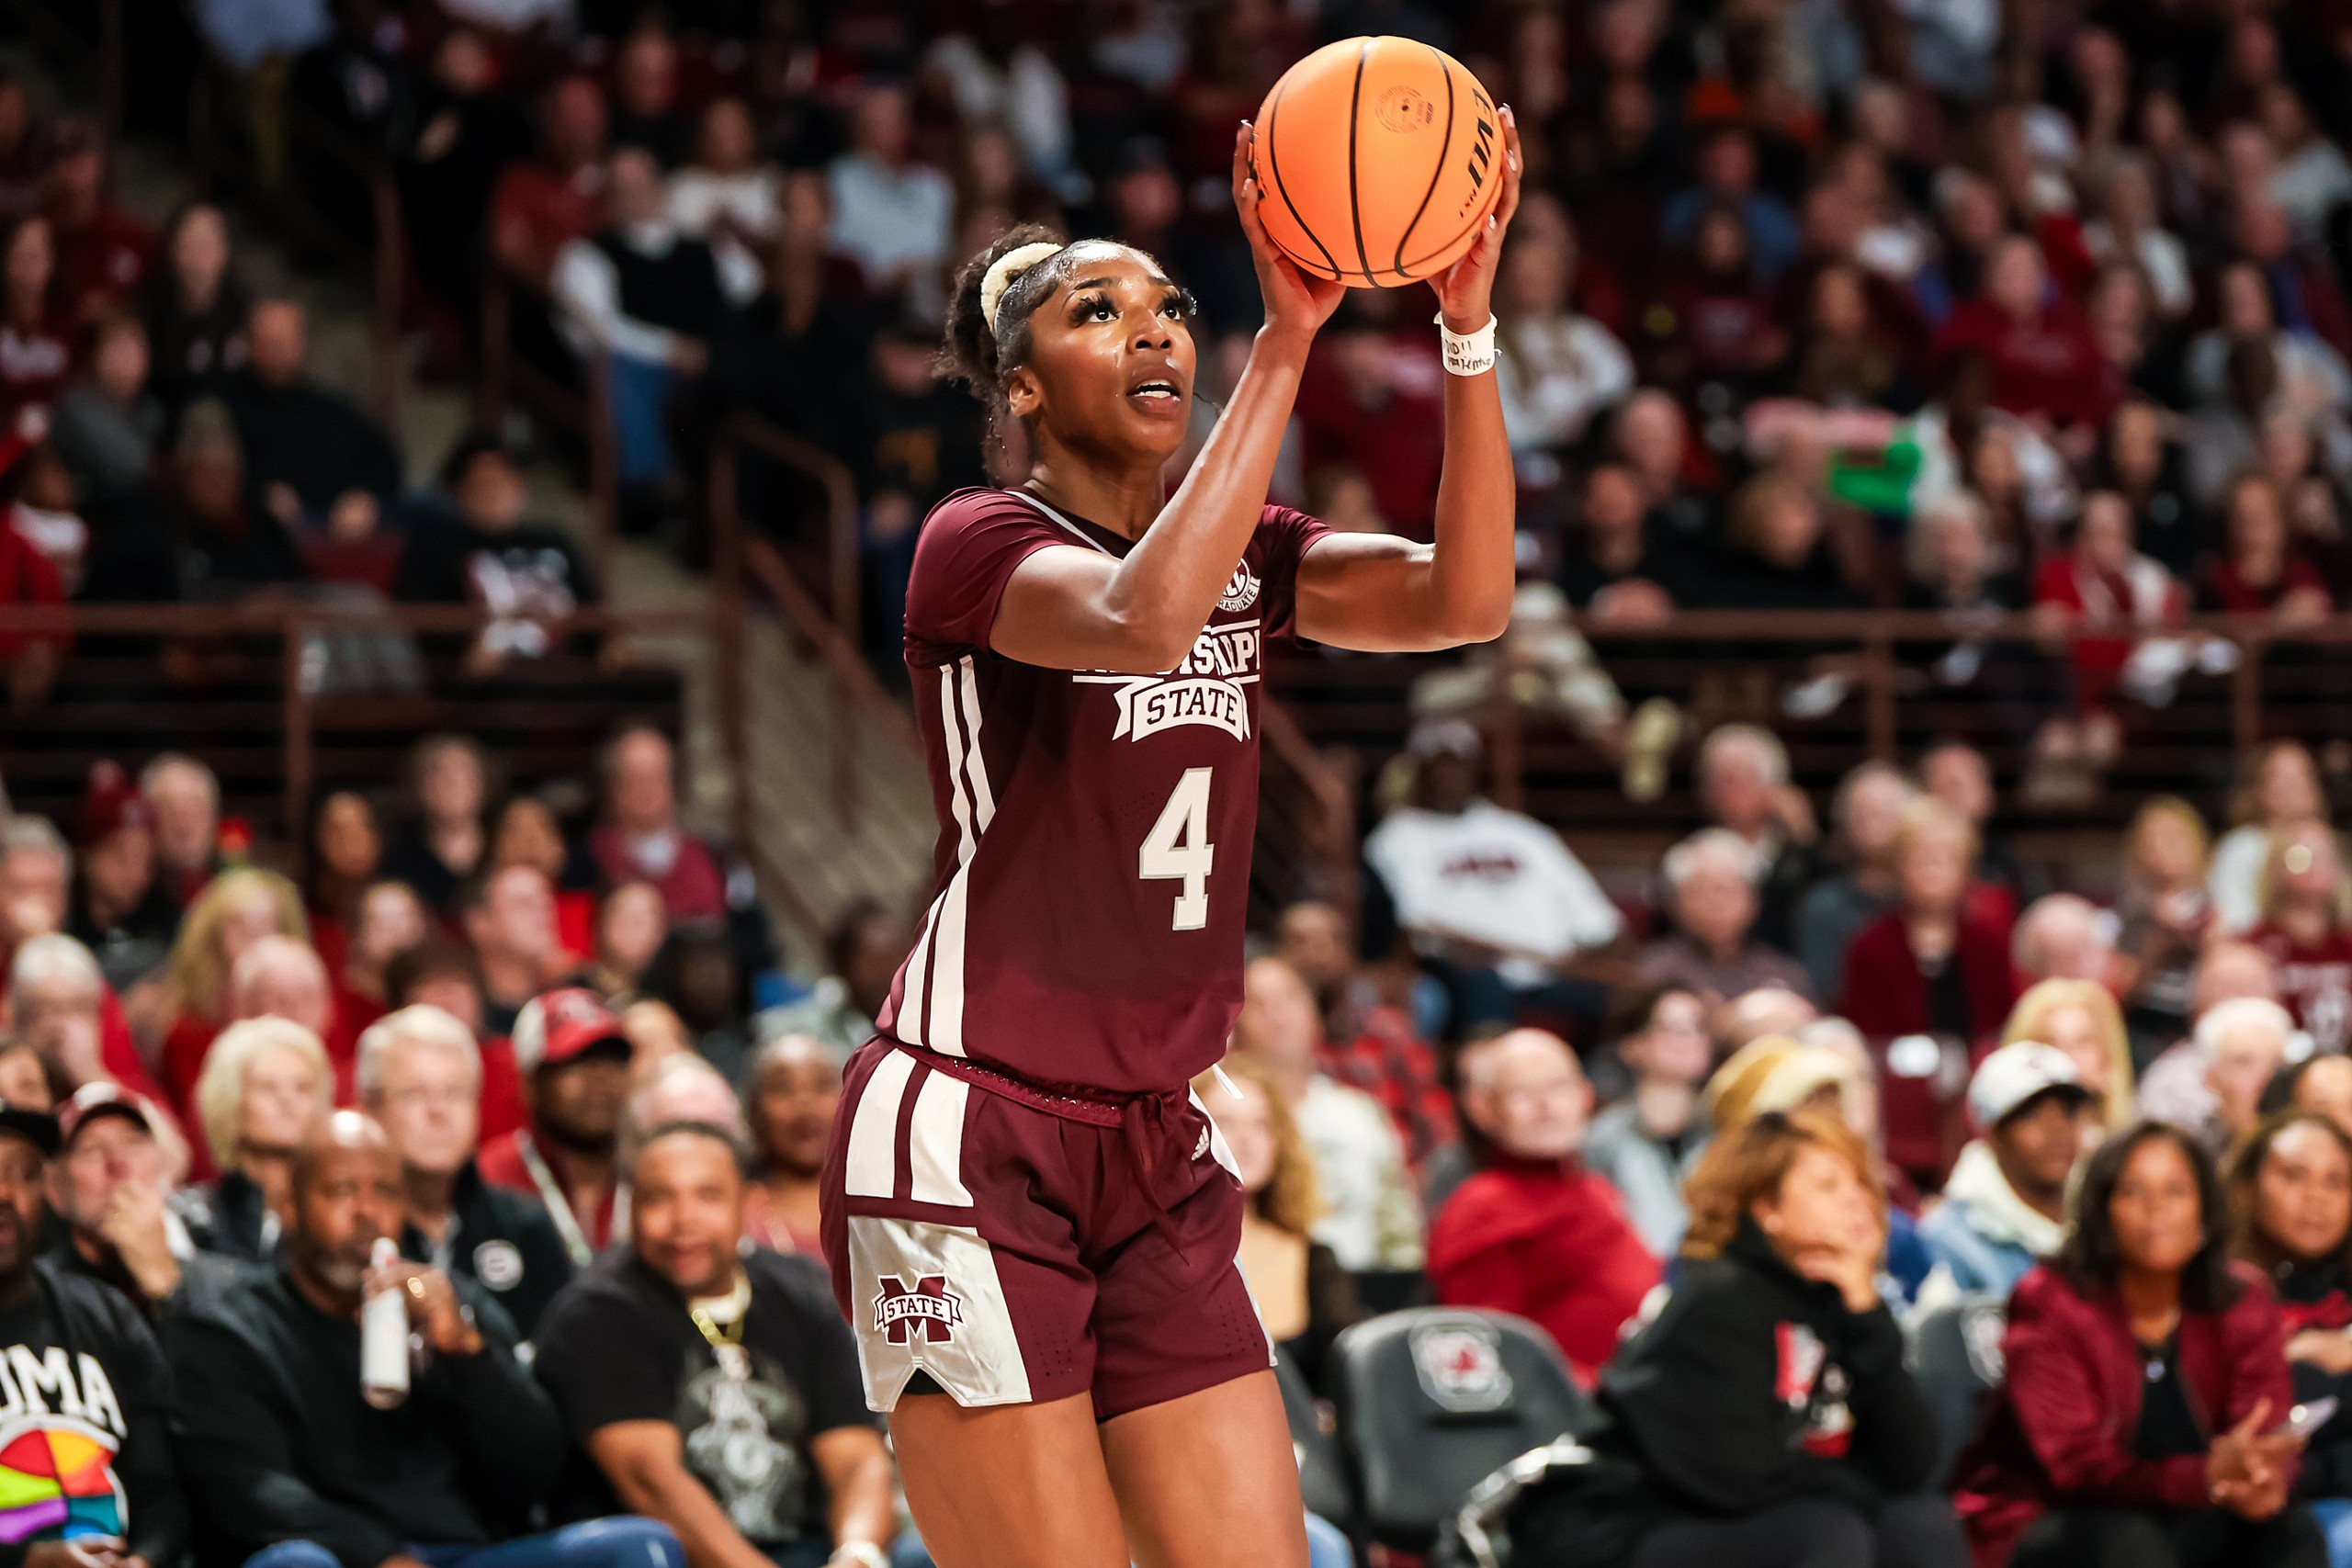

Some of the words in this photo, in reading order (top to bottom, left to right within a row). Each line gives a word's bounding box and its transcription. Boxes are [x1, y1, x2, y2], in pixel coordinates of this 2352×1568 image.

[1217, 589, 1257, 612] RADUATE
[1147, 686, 1238, 727] STATE
[1139, 766, 1215, 931] 4
[887, 1297, 944, 1318] STATE
